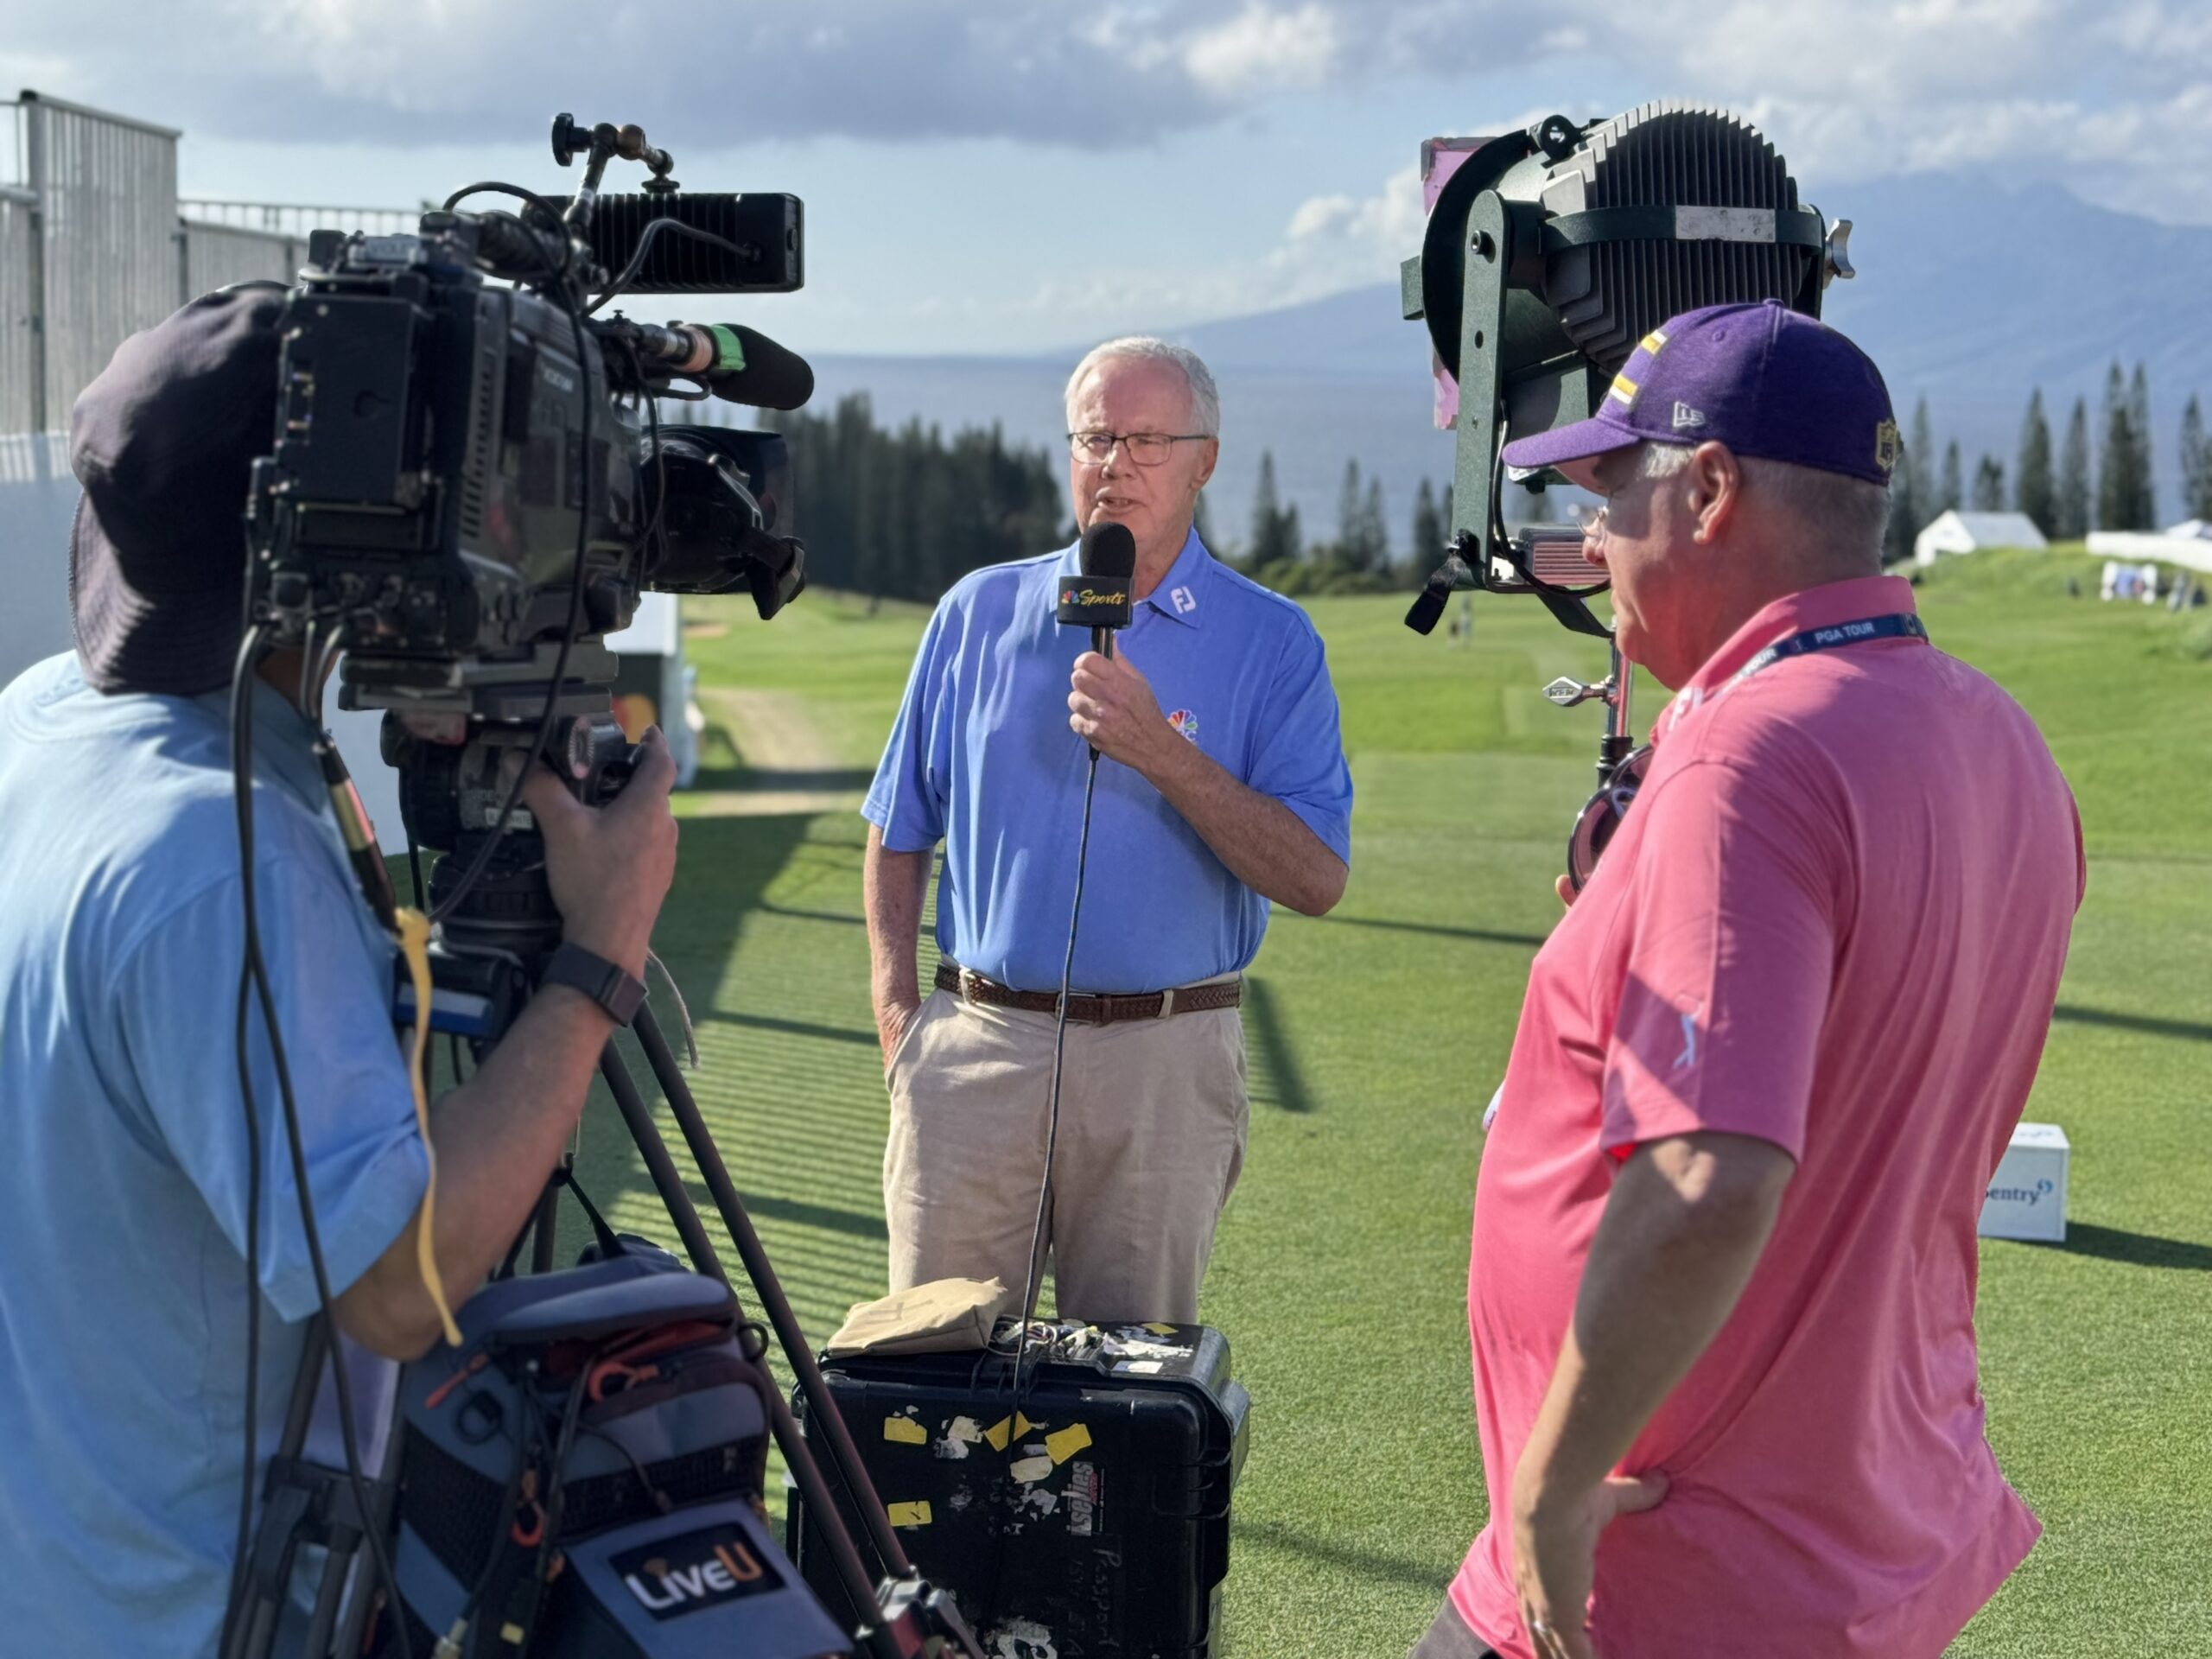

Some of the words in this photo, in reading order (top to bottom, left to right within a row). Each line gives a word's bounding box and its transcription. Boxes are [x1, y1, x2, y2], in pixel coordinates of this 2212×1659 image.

[1079, 589, 1125, 607] Sports
[1815, 630, 1844, 644] PGA
[1844, 622, 1875, 638] TOUR
